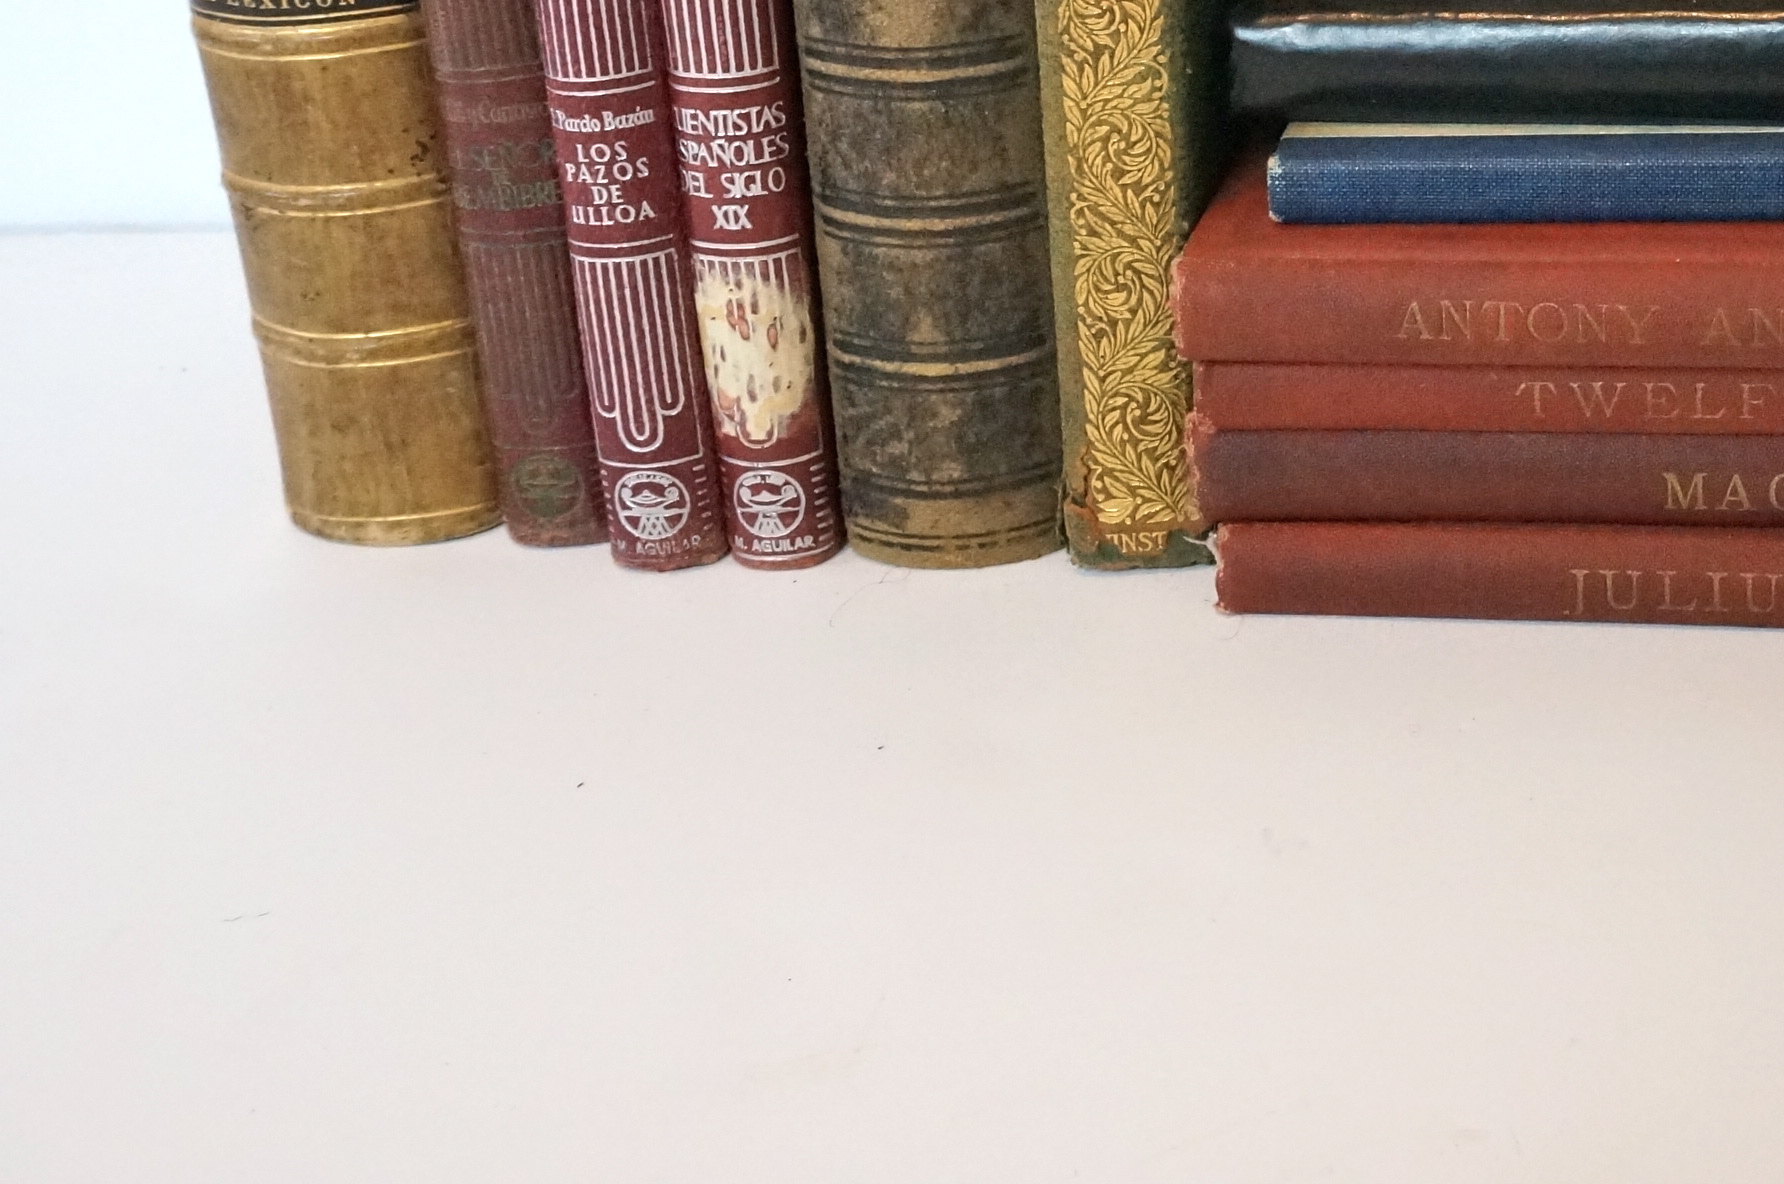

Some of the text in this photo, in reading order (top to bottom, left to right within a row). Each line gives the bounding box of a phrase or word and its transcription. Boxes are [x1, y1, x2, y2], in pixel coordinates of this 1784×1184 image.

[551, 108, 601, 133] Pardo
[602, 105, 655, 132] Bazán
[672, 101, 787, 137] UENTISTAS
[575, 140, 628, 163] LOS
[678, 131, 791, 169] SPAÑOLES
[565, 156, 650, 184] PAZOS
[679, 164, 787, 199] DEL SIGLO
[590, 183, 625, 205] DE
[571, 200, 657, 226] ULLOA
[711, 204, 754, 230] XIX
[1398, 298, 1661, 346] ANTONY
[635, 533, 702, 557] AGUILAR
[752, 533, 816, 553] AGUILAR
